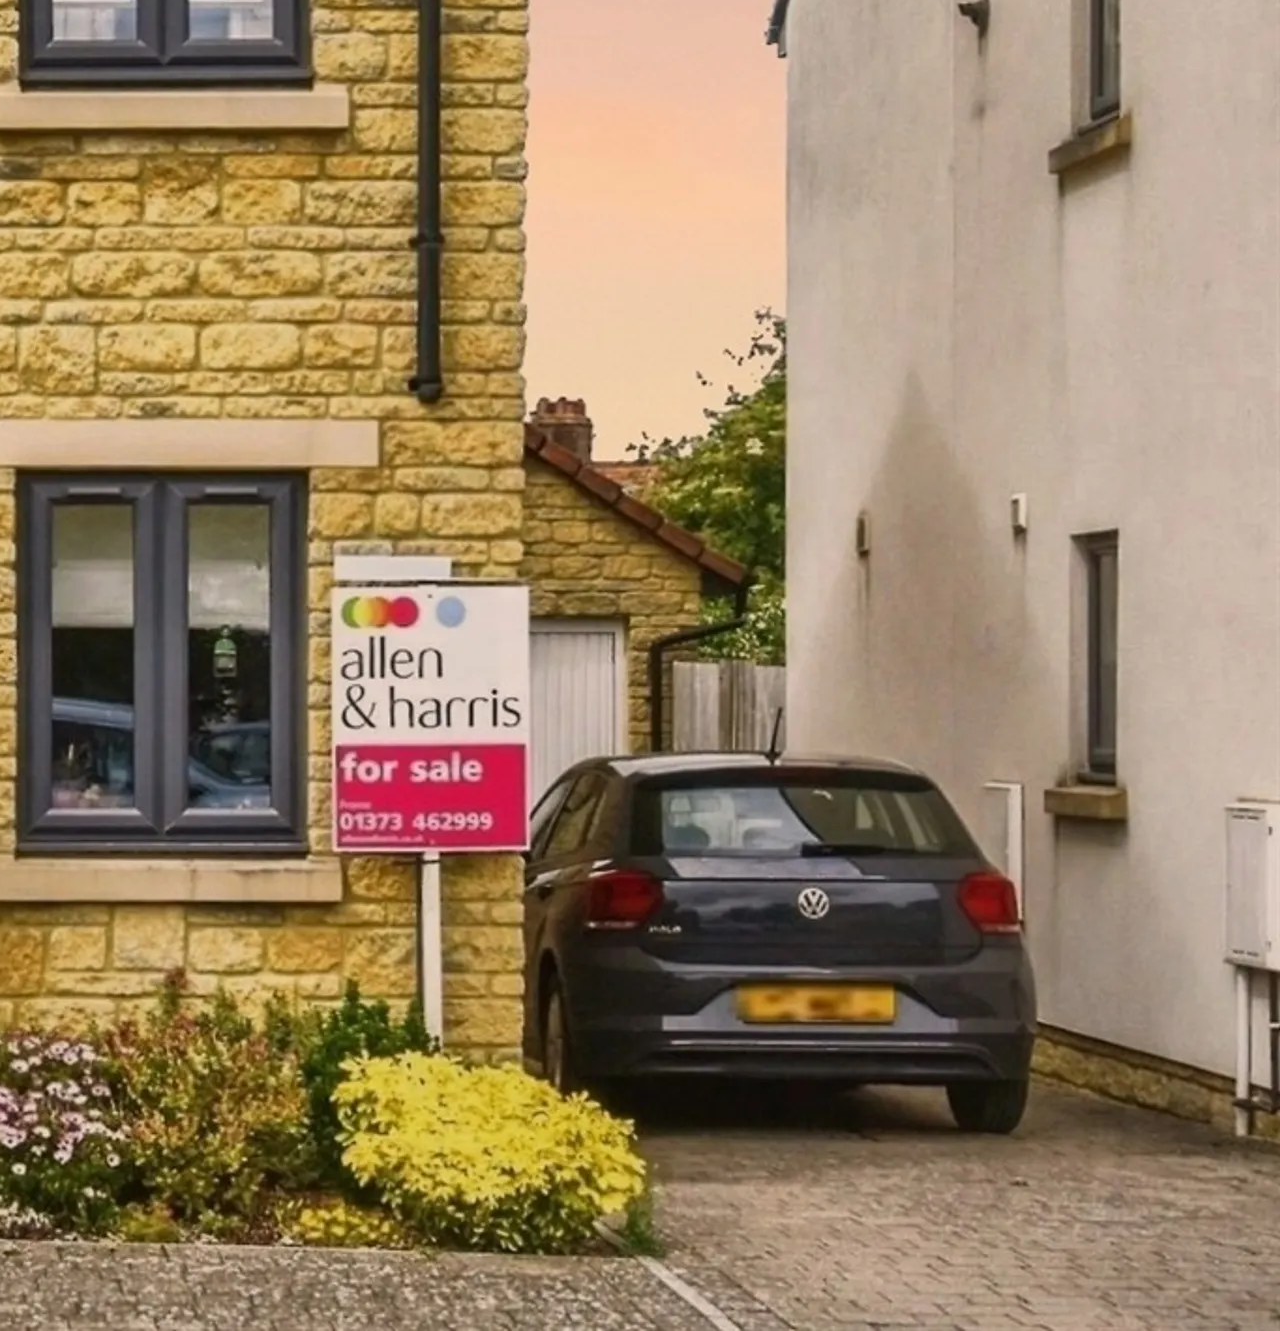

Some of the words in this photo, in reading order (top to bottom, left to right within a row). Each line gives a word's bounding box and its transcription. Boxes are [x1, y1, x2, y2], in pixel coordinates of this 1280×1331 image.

[340, 636, 443, 680] allen
[341, 684, 376, 729] &
[389, 686, 522, 729] harris
[340, 751, 398, 783] for
[409, 751, 483, 783] sale
[341, 812, 402, 831] 01373
[412, 812, 493, 831] 462999
